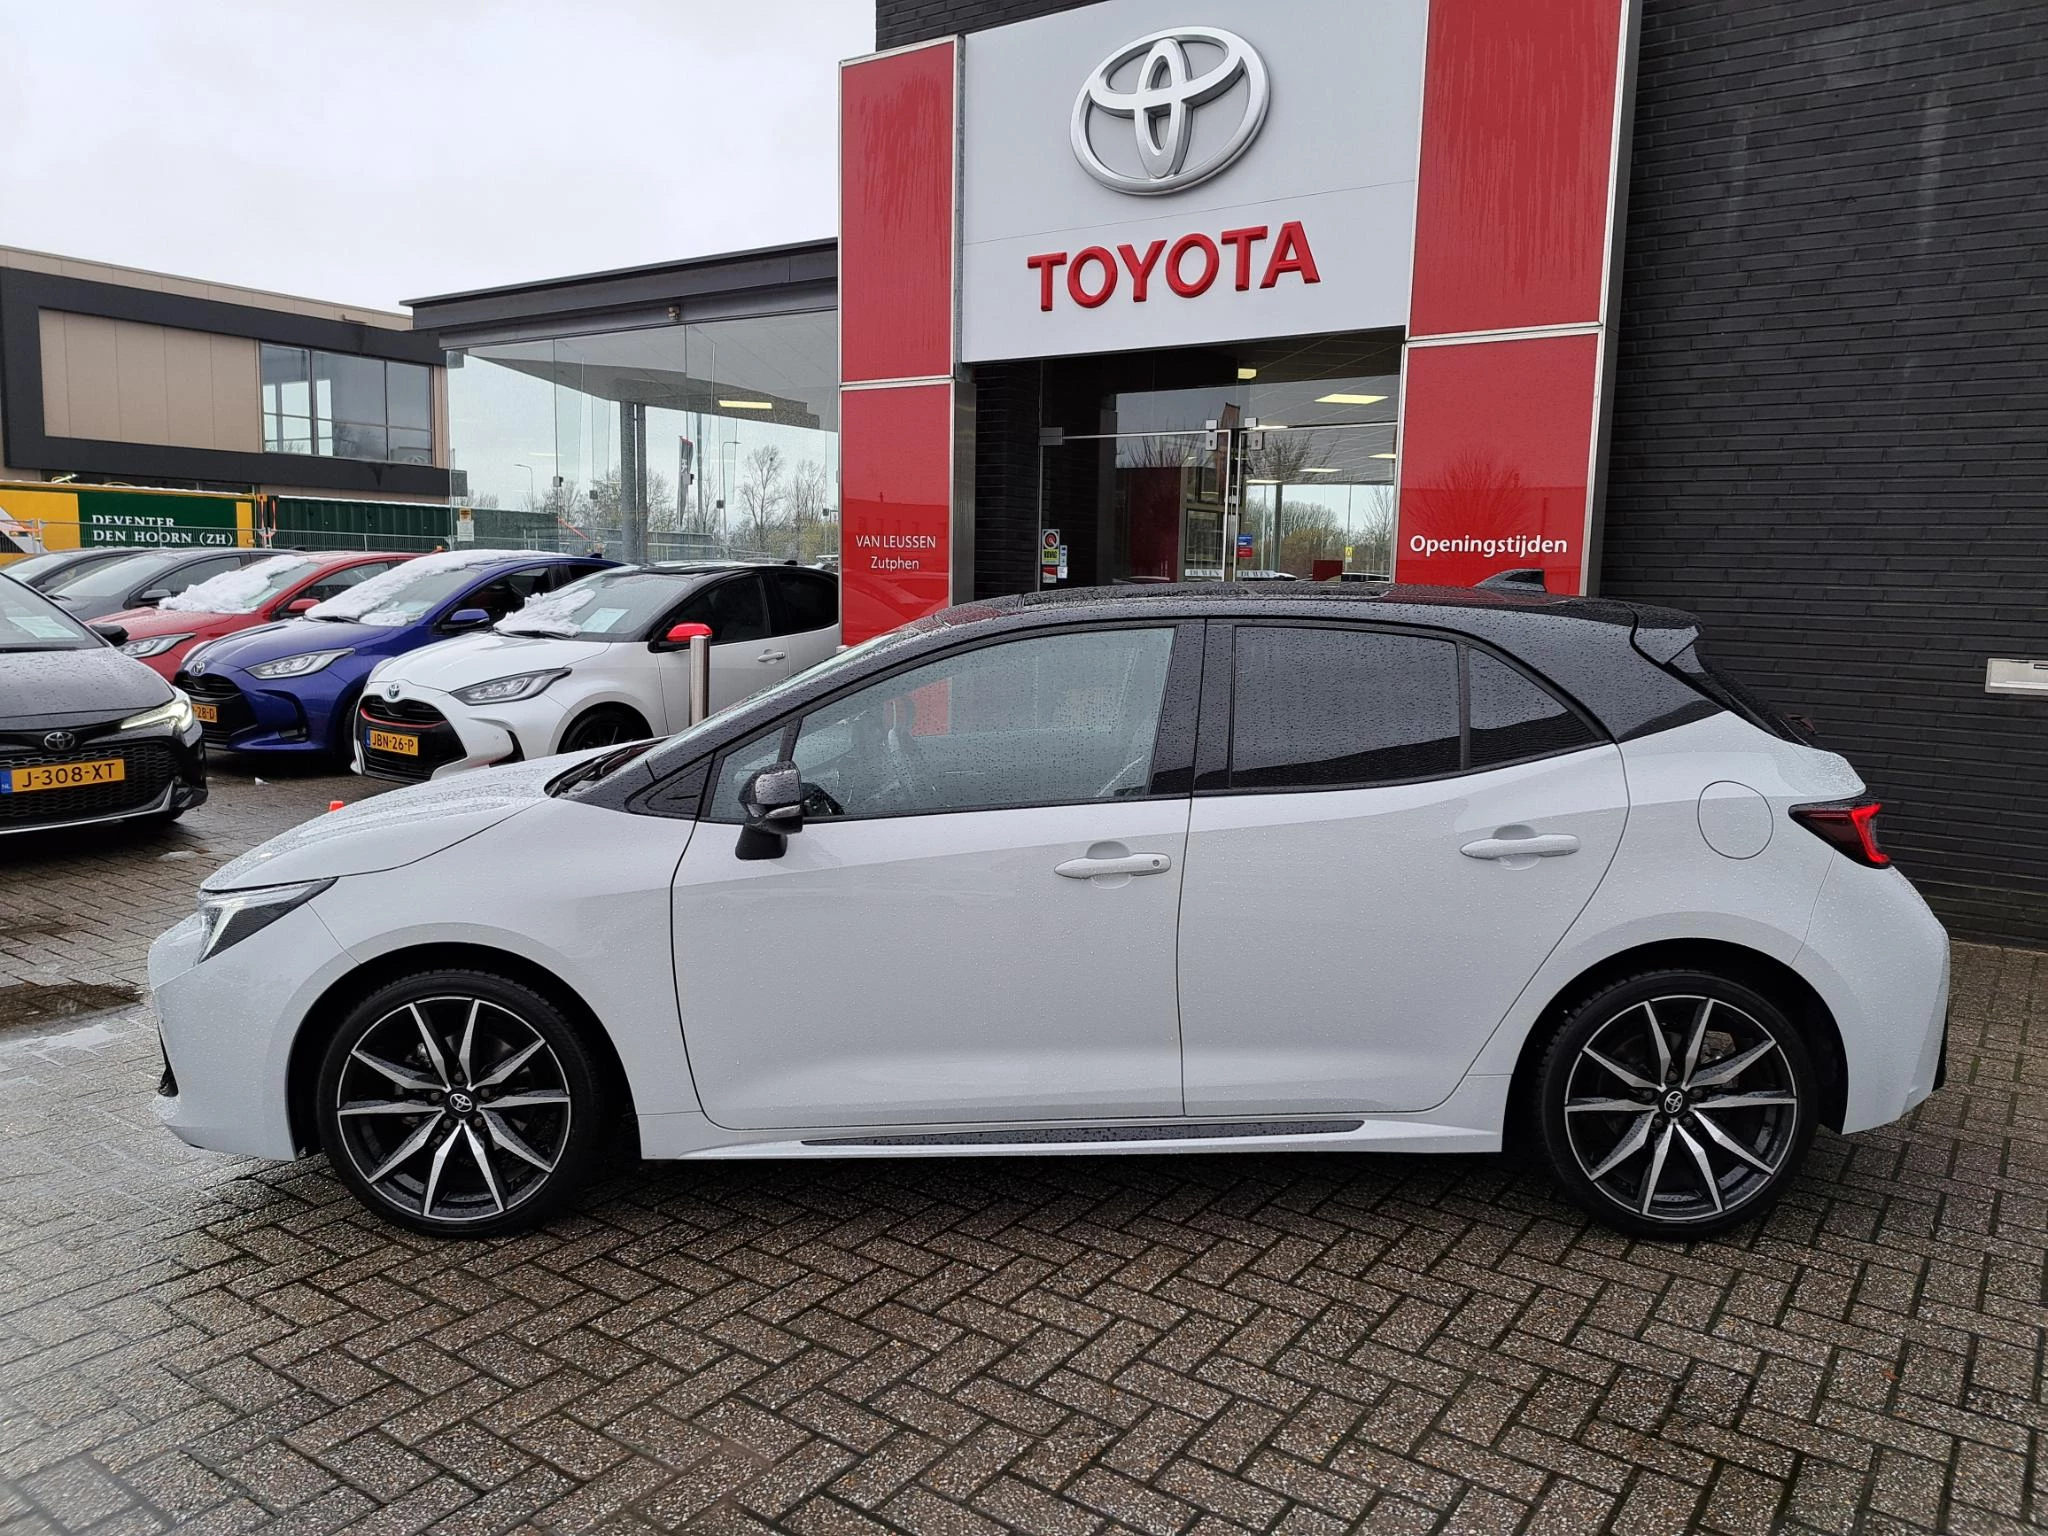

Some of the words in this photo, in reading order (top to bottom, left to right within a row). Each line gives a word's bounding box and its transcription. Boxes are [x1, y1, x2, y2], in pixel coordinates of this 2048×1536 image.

[1027, 220, 1321, 312] TOYOTA
[92, 514, 175, 527] DEVENTER
[93, 529, 126, 542] DEN
[134, 530, 192, 544] HOORN
[199, 531, 233, 546] (ZH)
[855, 534, 880, 548] VAN
[883, 535, 936, 549] LEUSSEN
[1409, 534, 1568, 558] Openingstijden
[870, 555, 920, 572] Zutphen
[372, 733, 414, 752] JBN-26-P
[22, 762, 116, 788] J-308-XT
